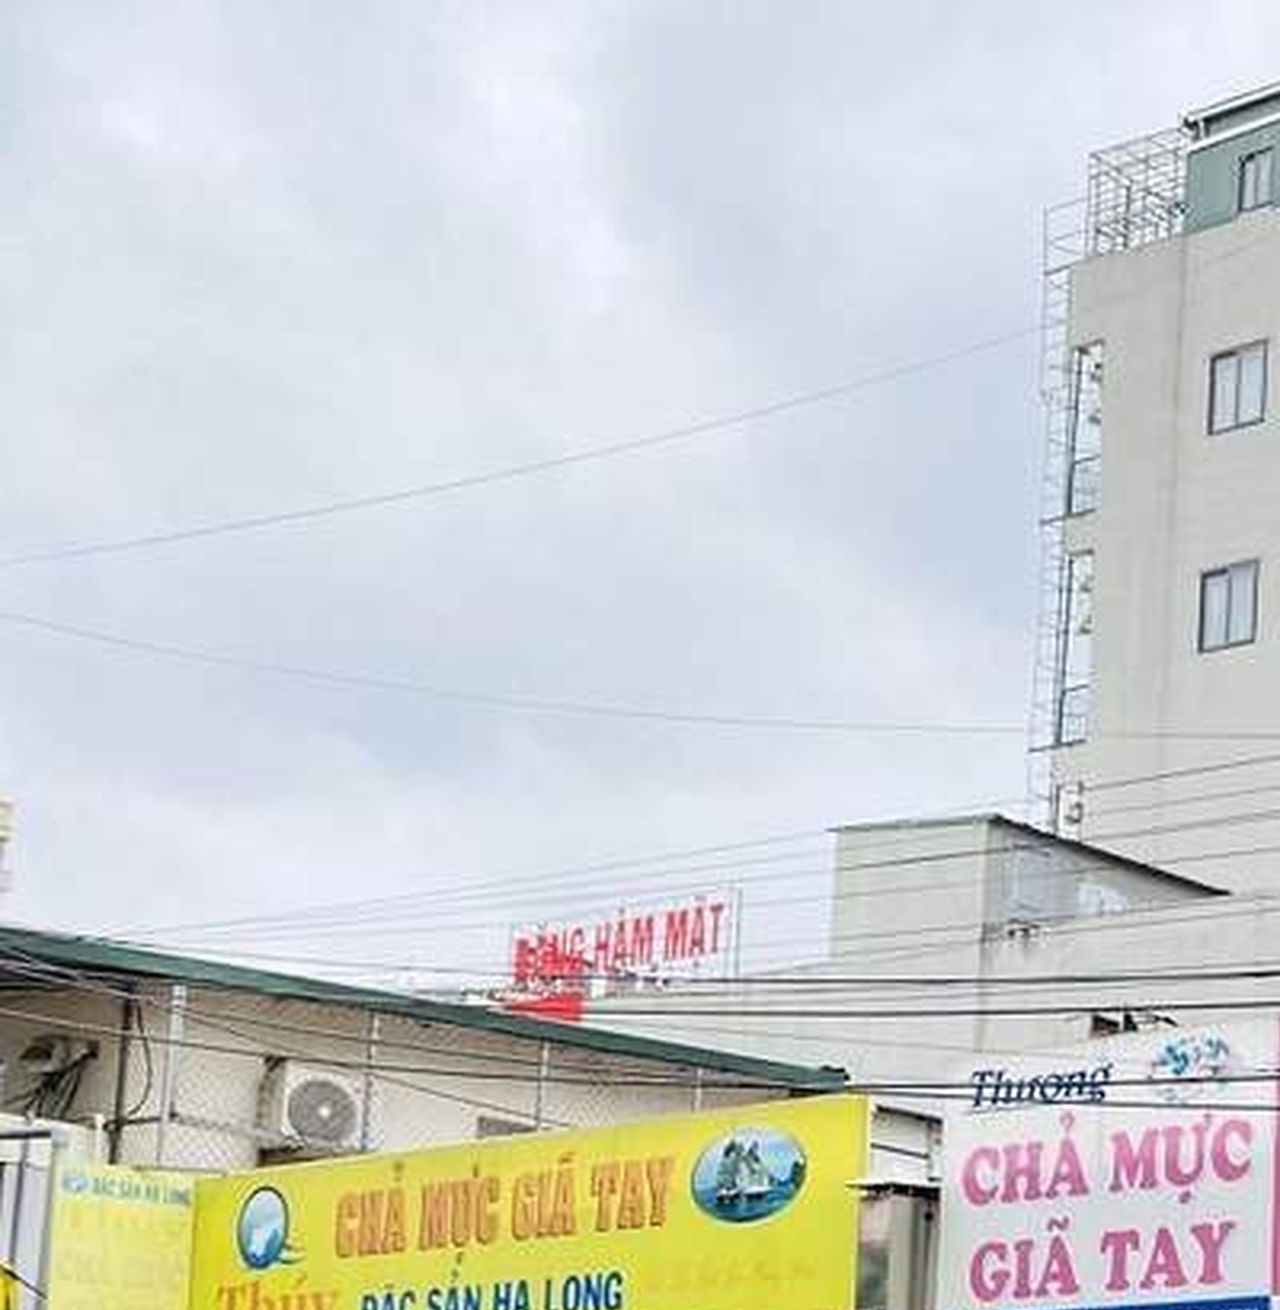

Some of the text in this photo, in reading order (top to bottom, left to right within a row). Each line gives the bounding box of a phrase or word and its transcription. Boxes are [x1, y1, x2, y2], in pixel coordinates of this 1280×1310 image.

[590, 1155, 677, 1233] TAY
[962, 1110, 1253, 1207] CHẢ MỰC
[969, 1216, 1236, 1302] GIÃ TAY
